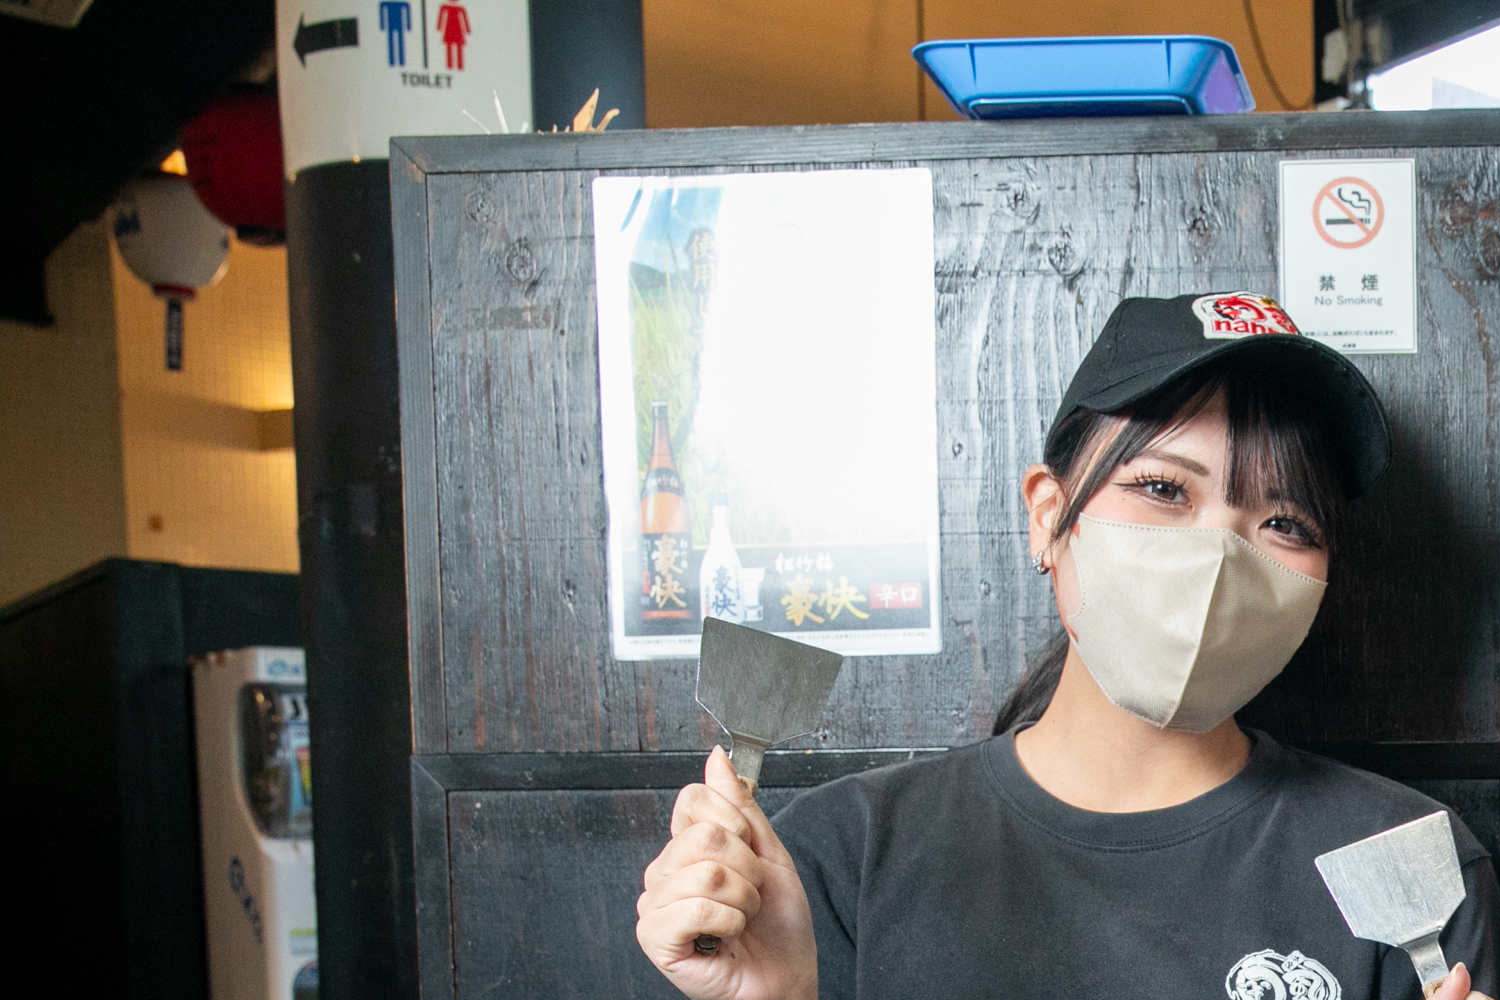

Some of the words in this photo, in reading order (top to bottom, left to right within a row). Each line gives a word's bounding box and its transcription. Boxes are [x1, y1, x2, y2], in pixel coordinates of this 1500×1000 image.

[400, 71, 453, 89] TOILET
[1319, 274, 1379, 291] 禁煙
[1314, 296, 1333, 307] No
[1337, 295, 1383, 307] Smoking
[780, 572, 870, 627] 豪快
[876, 583, 919, 608] 辛口
